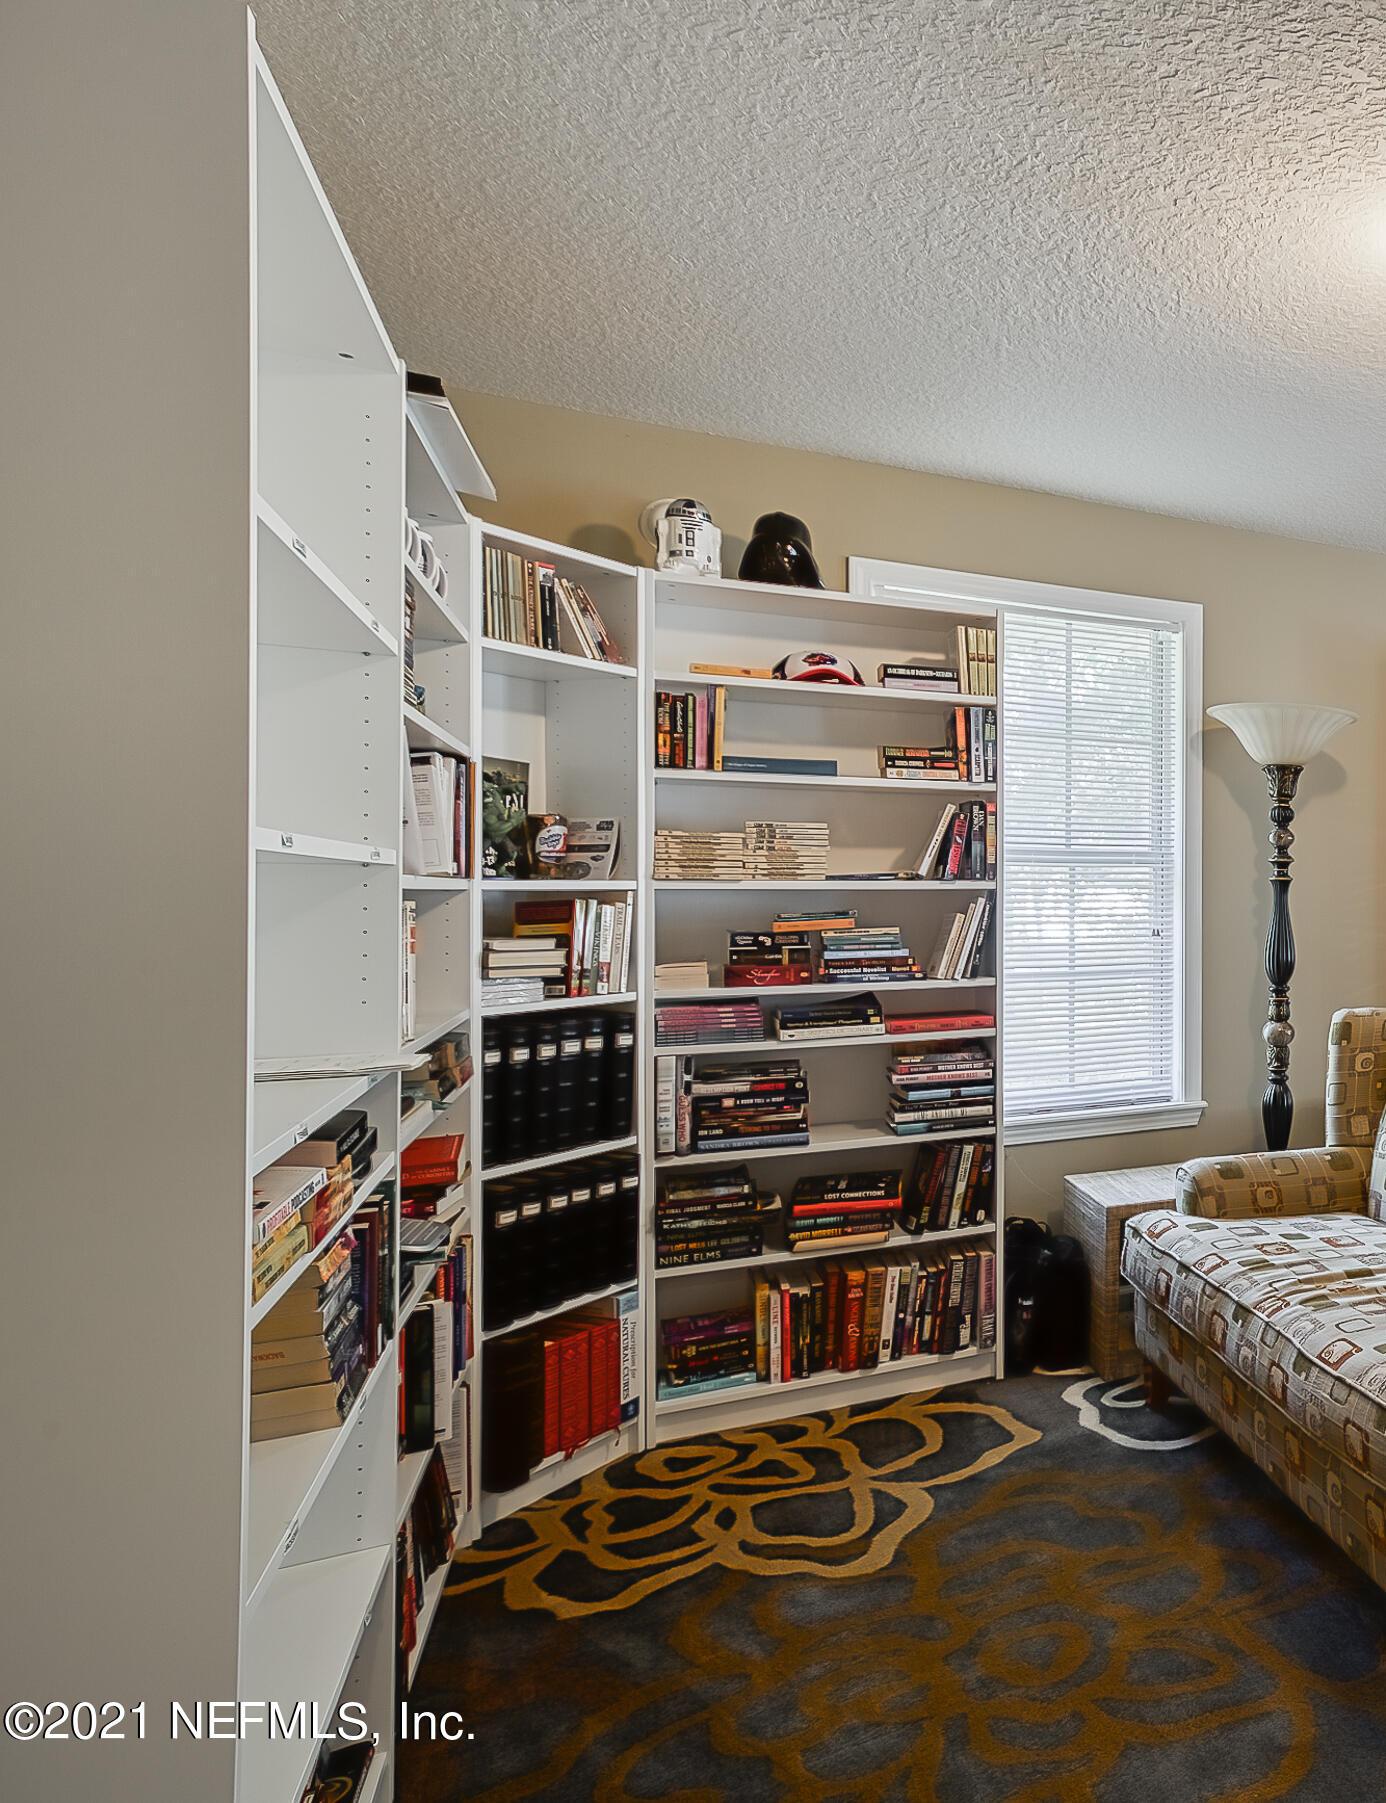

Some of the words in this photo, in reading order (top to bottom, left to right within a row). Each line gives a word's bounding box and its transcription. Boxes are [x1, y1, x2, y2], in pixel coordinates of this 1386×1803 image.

[840, 1190, 885, 1199] CONNECTIONS
[659, 1255, 689, 1265] NINE
[693, 1251, 721, 1260] ELMS
[629, 1321, 637, 1368] Prescription
[622, 1366, 630, 1400] CURES
